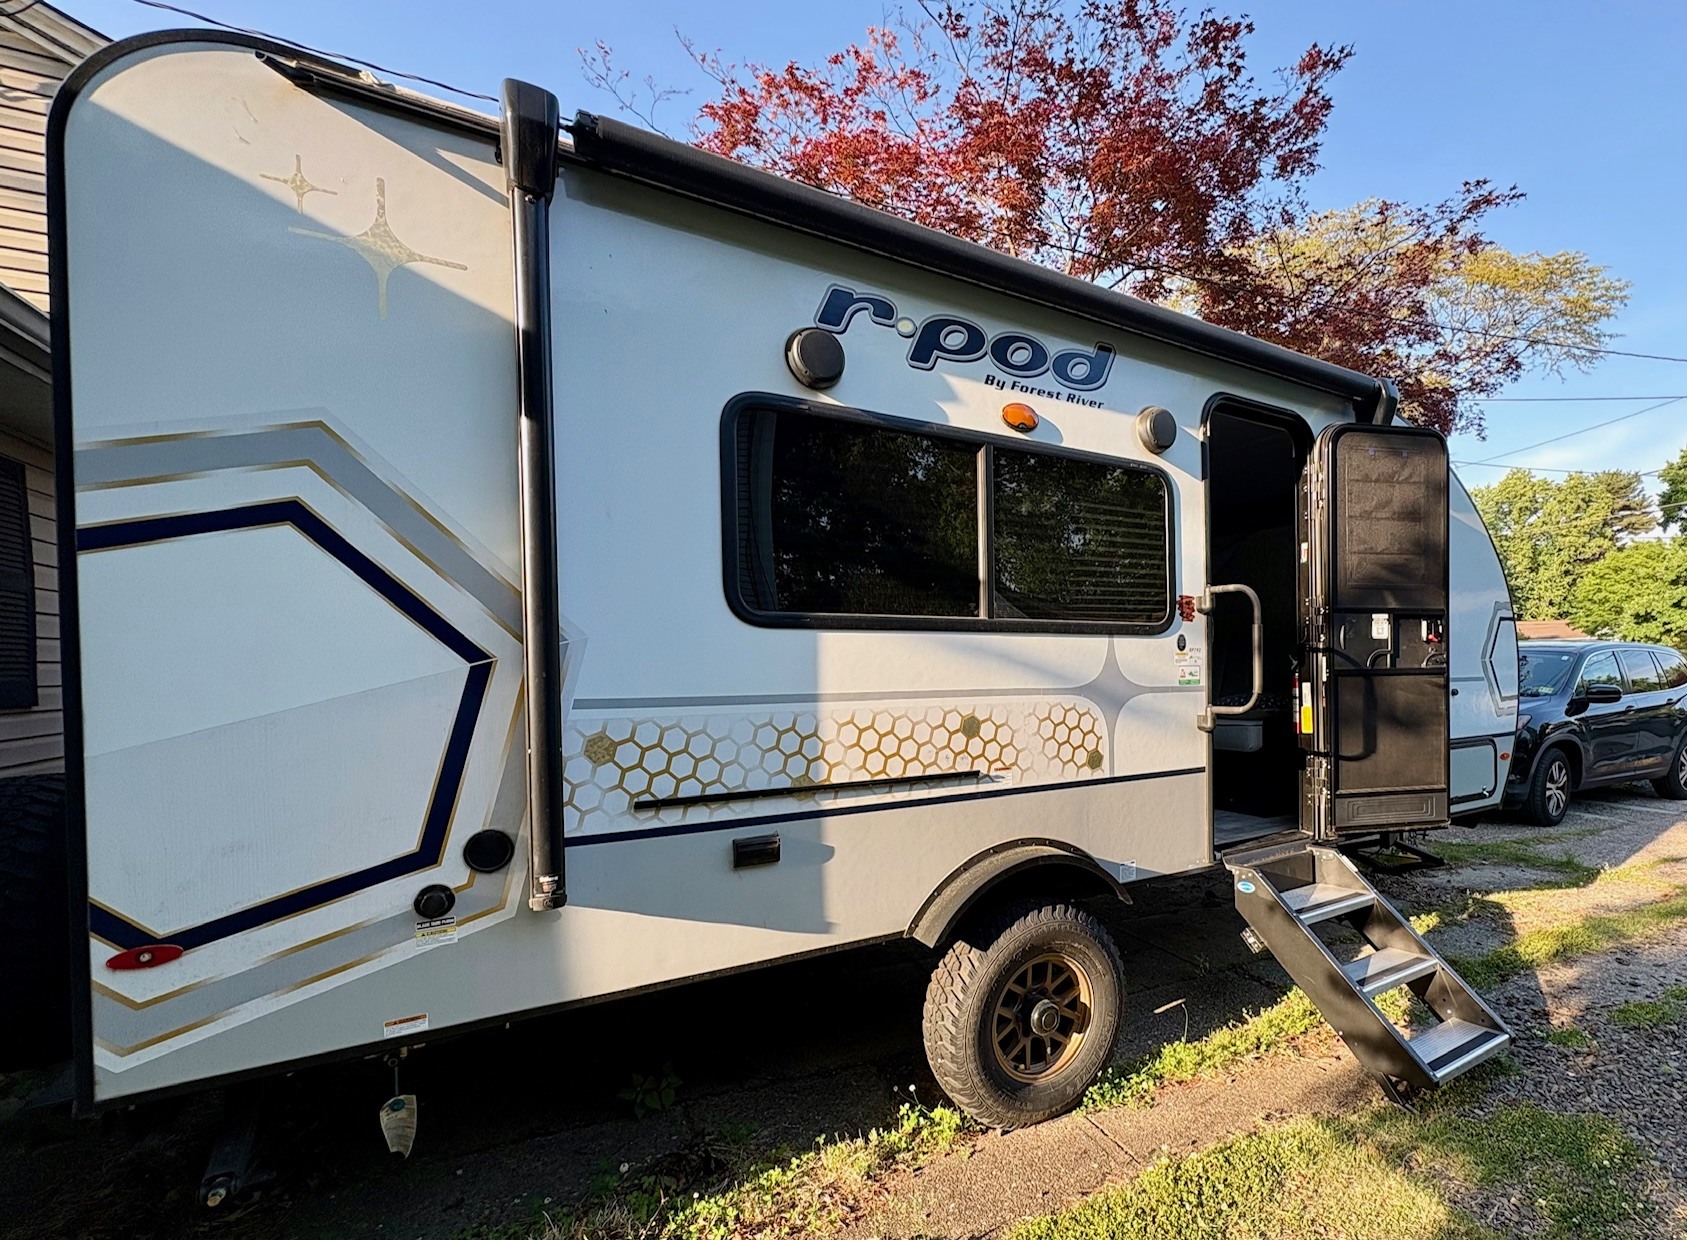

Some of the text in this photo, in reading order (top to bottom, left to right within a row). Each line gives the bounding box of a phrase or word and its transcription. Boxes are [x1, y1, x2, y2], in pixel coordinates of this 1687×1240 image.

[984, 373, 1105, 409] By Forest River
